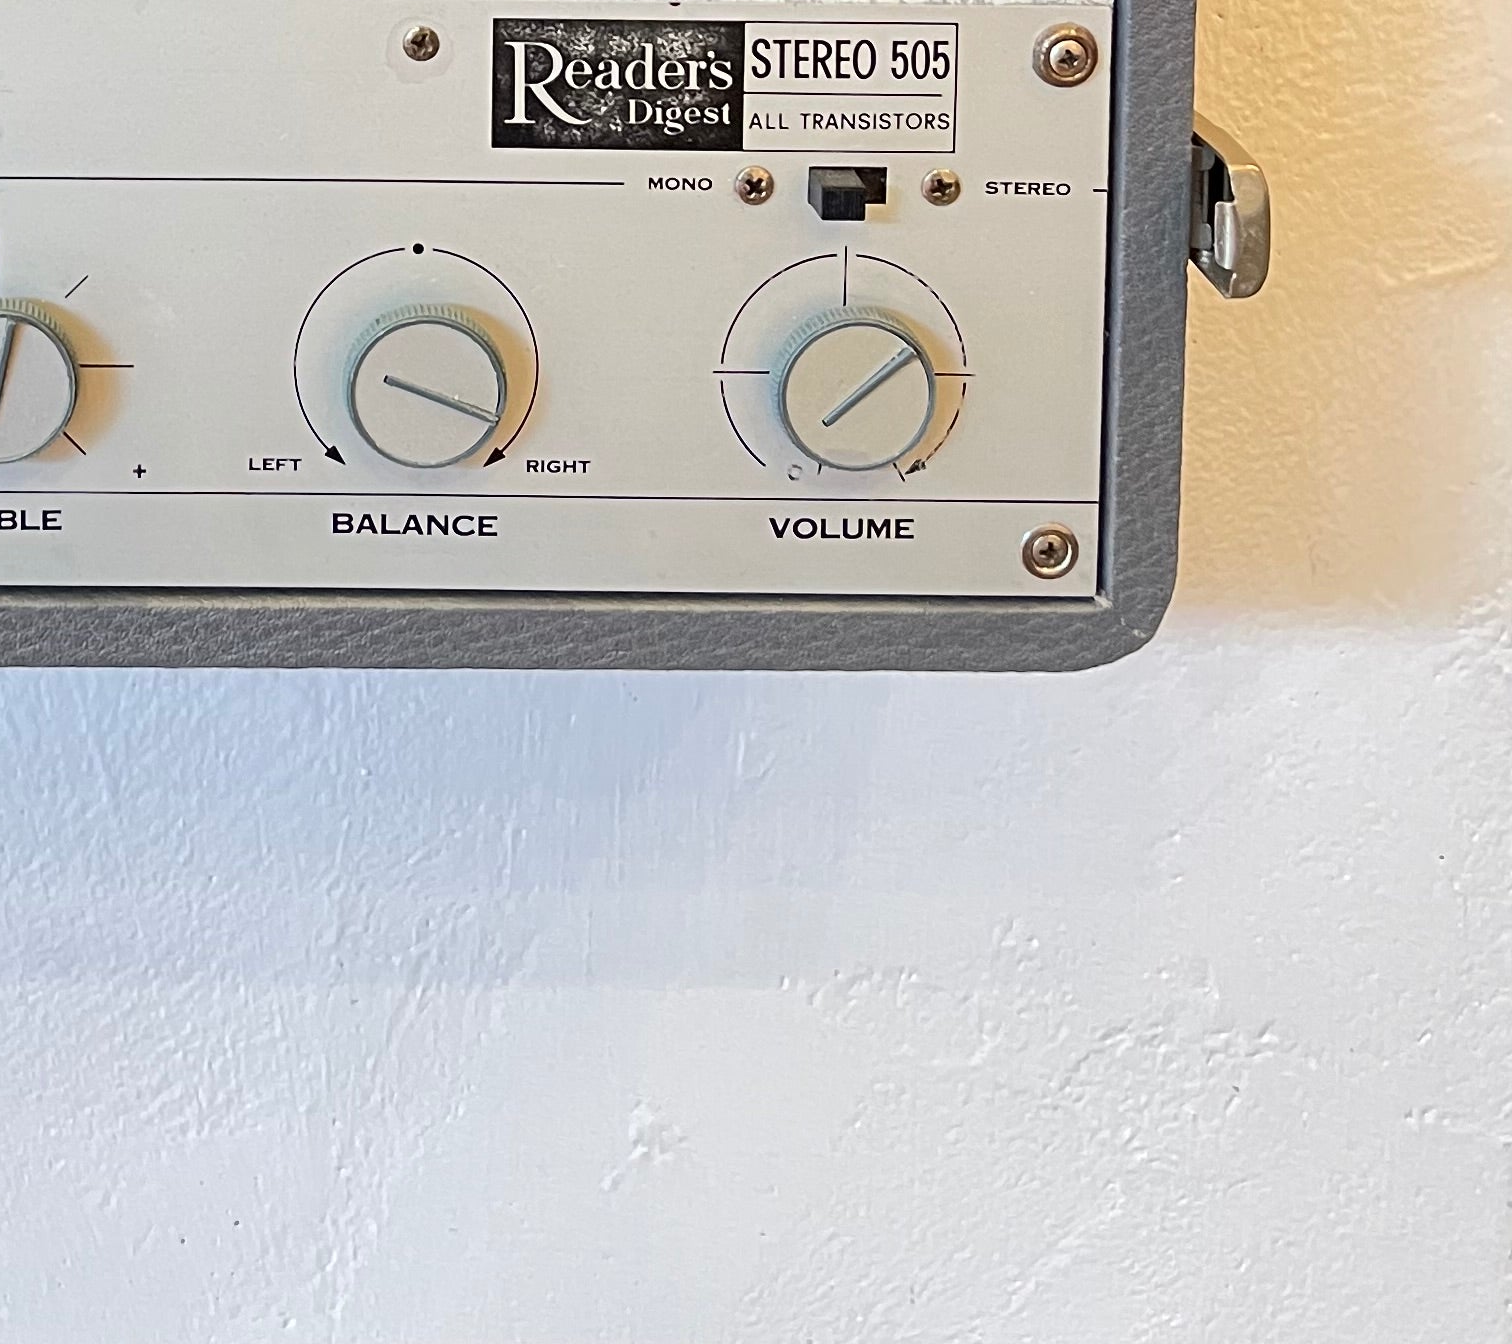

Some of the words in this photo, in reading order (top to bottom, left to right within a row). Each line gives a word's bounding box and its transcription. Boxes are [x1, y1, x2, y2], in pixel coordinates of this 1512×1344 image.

[751, 38, 877, 80] STEREO
[890, 39, 951, 80] 505
[503, 41, 734, 125] Reader's
[627, 98, 732, 136] Digest
[748, 112, 790, 130] ALL
[799, 112, 951, 131] TRANSISTORS
[648, 176, 713, 192] MONO
[984, 180, 1072, 196] STEREO
[248, 457, 303, 472] LEFT
[526, 459, 592, 474] RIGHT
[331, 512, 500, 537] BALANCE
[768, 517, 916, 540] VOLUME
